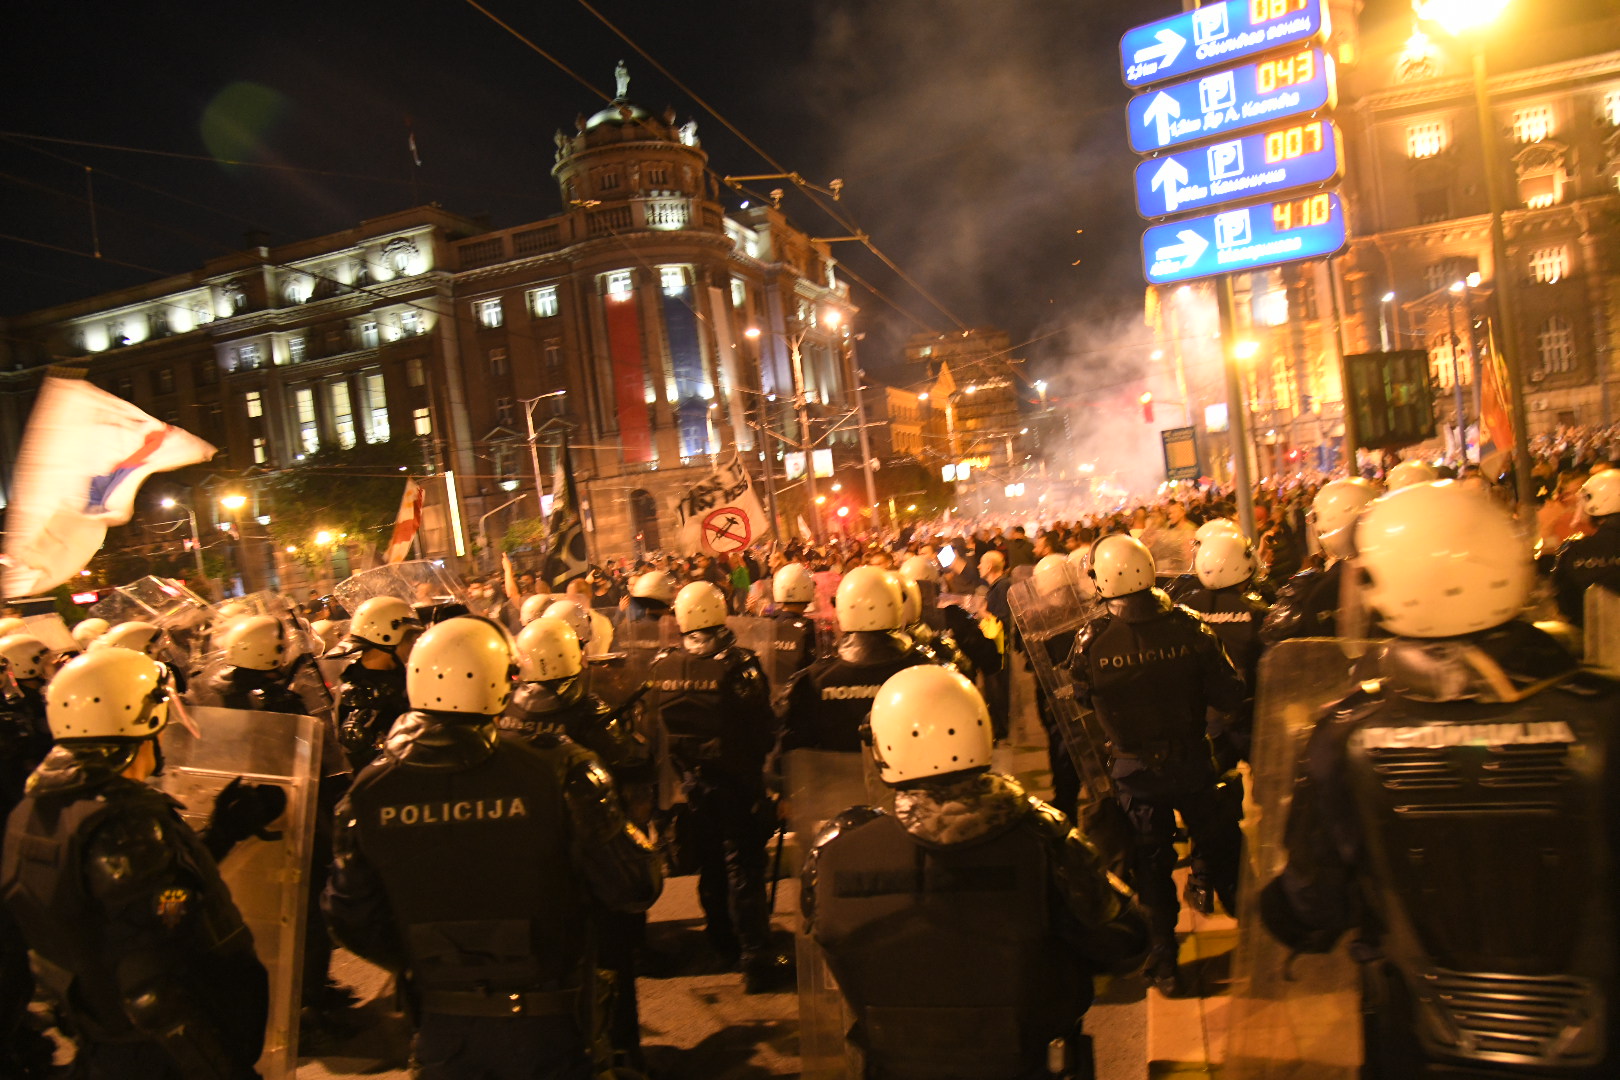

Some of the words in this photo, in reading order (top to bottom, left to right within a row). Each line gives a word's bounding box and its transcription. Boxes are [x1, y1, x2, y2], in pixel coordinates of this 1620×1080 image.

[1256, 50, 1314, 95] 043
[1265, 121, 1323, 164] 007
[1273, 193, 1330, 230] 410
[1099, 644, 1192, 670] POLICIJA
[379, 797, 527, 827] POLICIJA
